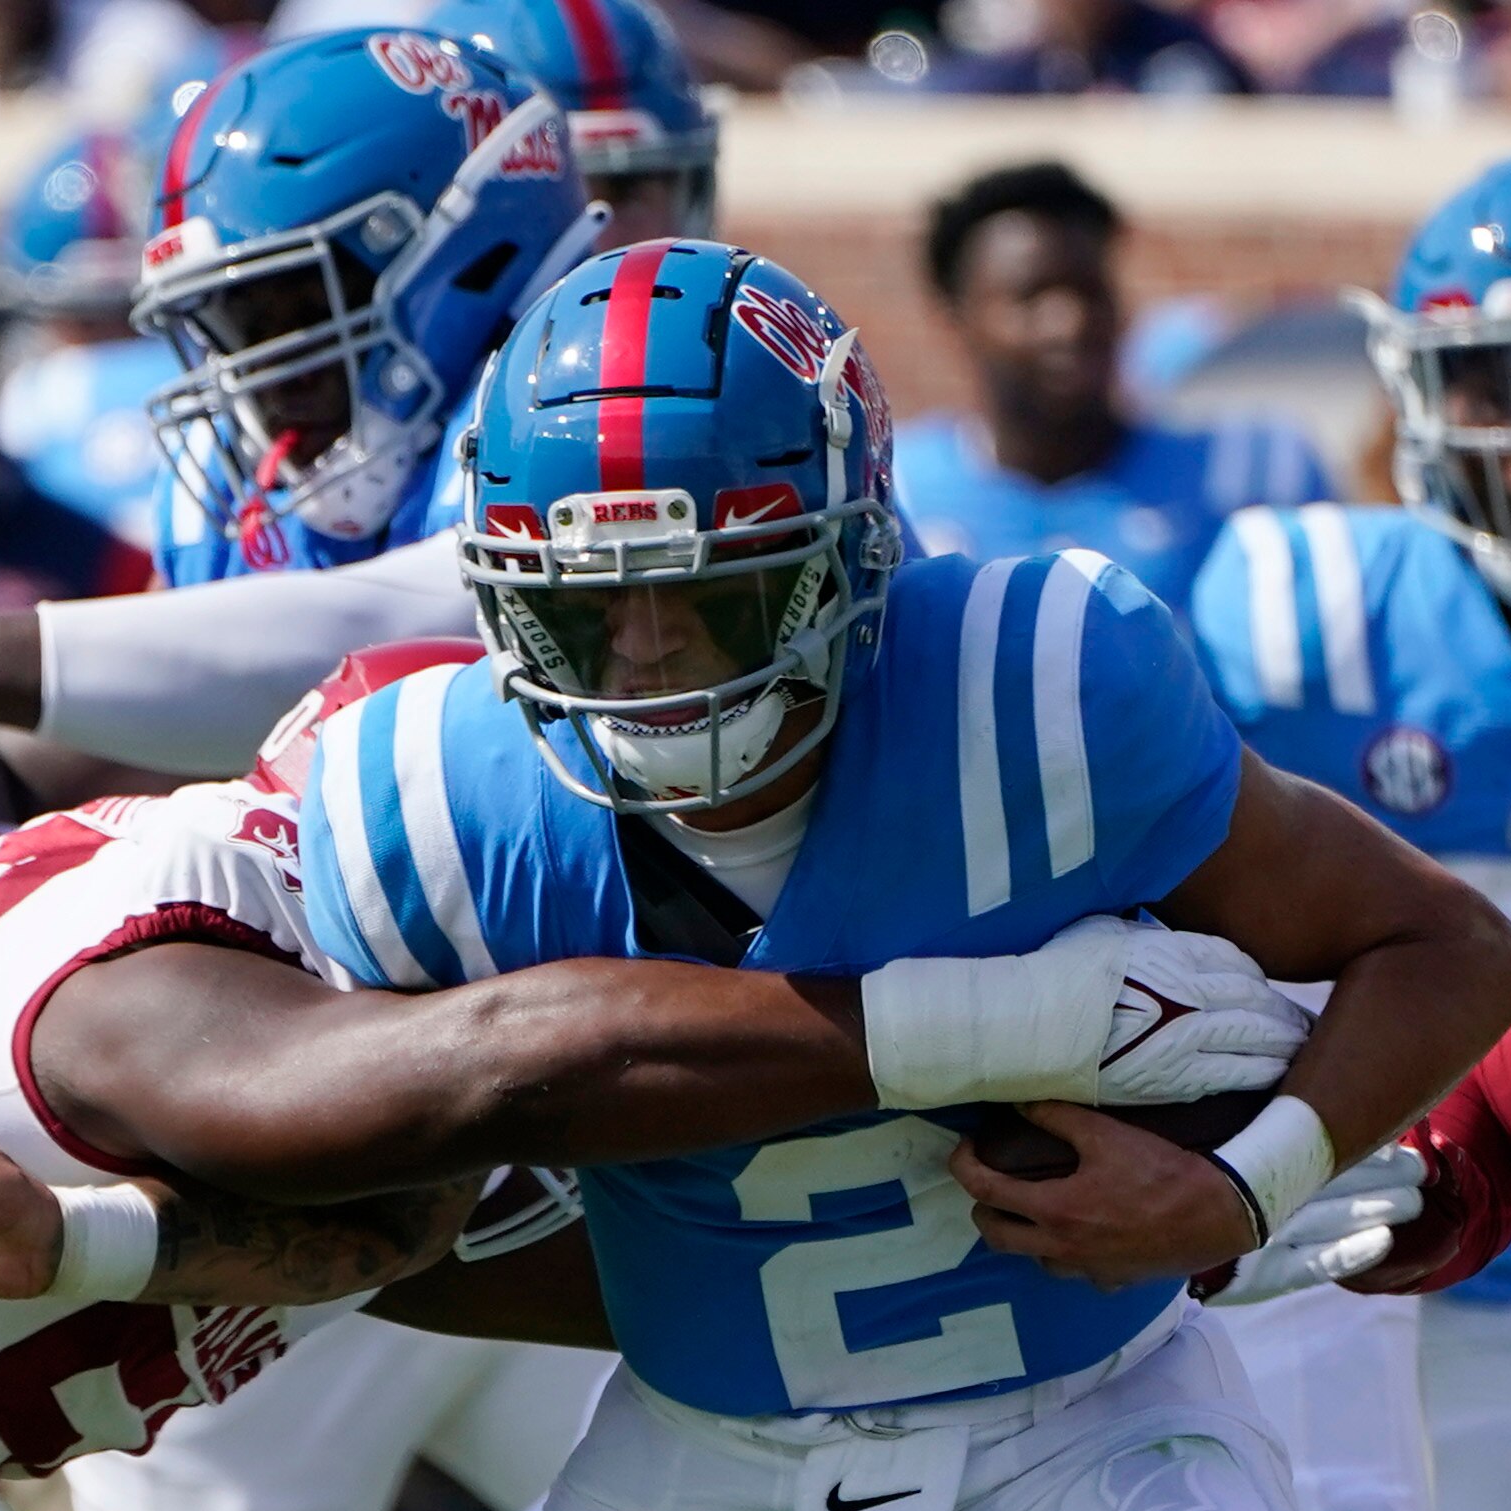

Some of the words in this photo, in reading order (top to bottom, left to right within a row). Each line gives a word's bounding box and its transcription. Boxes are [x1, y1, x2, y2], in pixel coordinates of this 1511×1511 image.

[369, 32, 473, 95] Ole
[592, 500, 658, 524] REBS
[512, 608, 567, 670] SPORT
[731, 1113, 1027, 1410] 2
